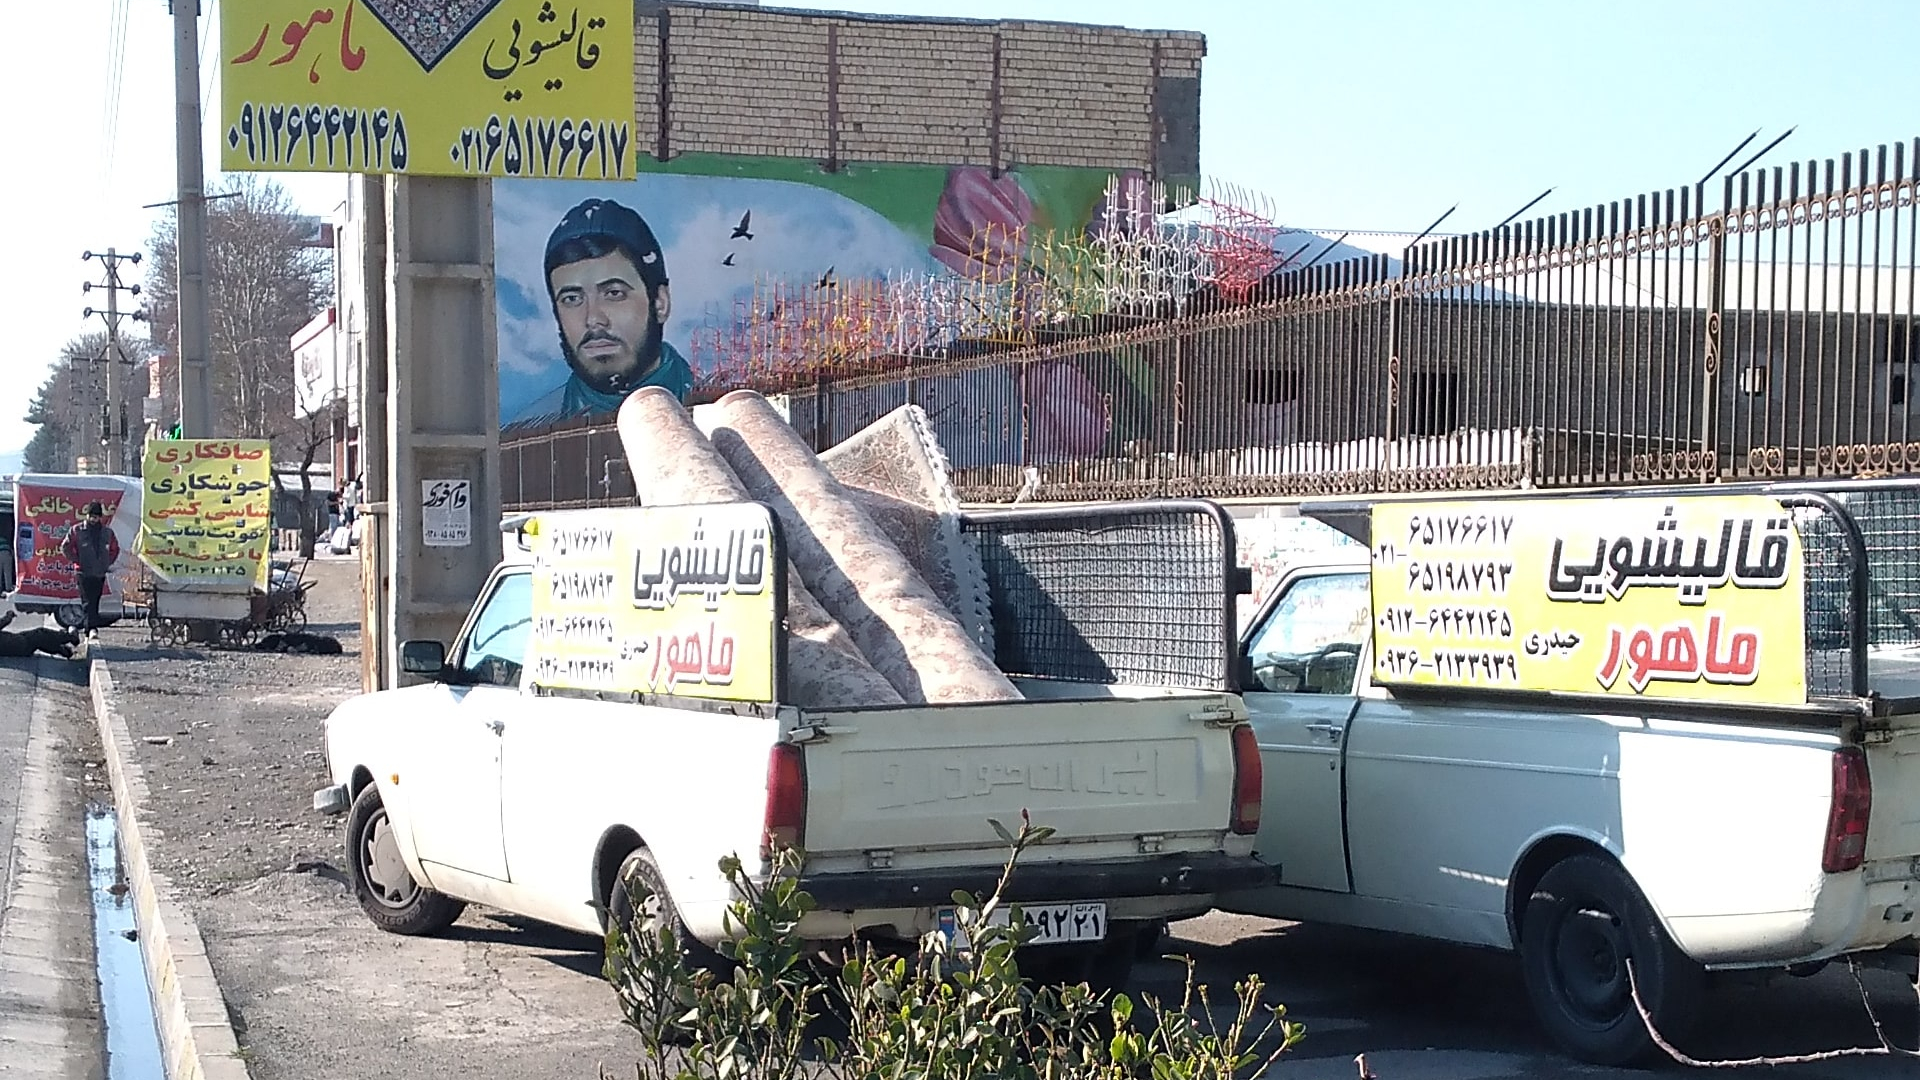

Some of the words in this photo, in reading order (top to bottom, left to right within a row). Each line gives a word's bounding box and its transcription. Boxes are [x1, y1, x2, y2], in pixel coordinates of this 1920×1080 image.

[230, 0, 367, 84] ماهور
[229, 103, 408, 171] ۰۹۱۲۶۴۴۲۱۴۵
[450, 115, 628, 177] ۰۲۱۶۵۱۷۶۶۱۷
[155, 441, 264, 463] صافکاری
[150, 473, 269, 497] جوشکاری
[25, 496, 74, 518] خانگی
[149, 501, 202, 519] کشی
[204, 503, 269, 521] شاسی
[1409, 515, 1514, 545] ۶۵۱۷۶۶۱۷
[248, 548, 263, 564] با
[634, 517, 765, 605] قالیشویی
[1547, 505, 1790, 599] قالیشویی
[1409, 562, 1513, 592] ۶۵۱۹۸۷۹۳
[1380, 607, 1513, 637] ۰۹۱۲-۶۴۴۲۱۴۵
[649, 621, 735, 686] ماهور
[1525, 627, 1580, 655] حیدری
[1600, 615, 1758, 684] ماهور
[1380, 649, 1518, 681] ۰۹۳۶-۲۱۳۳۹۳۹
[1073, 913, 1100, 937] ۲۱
